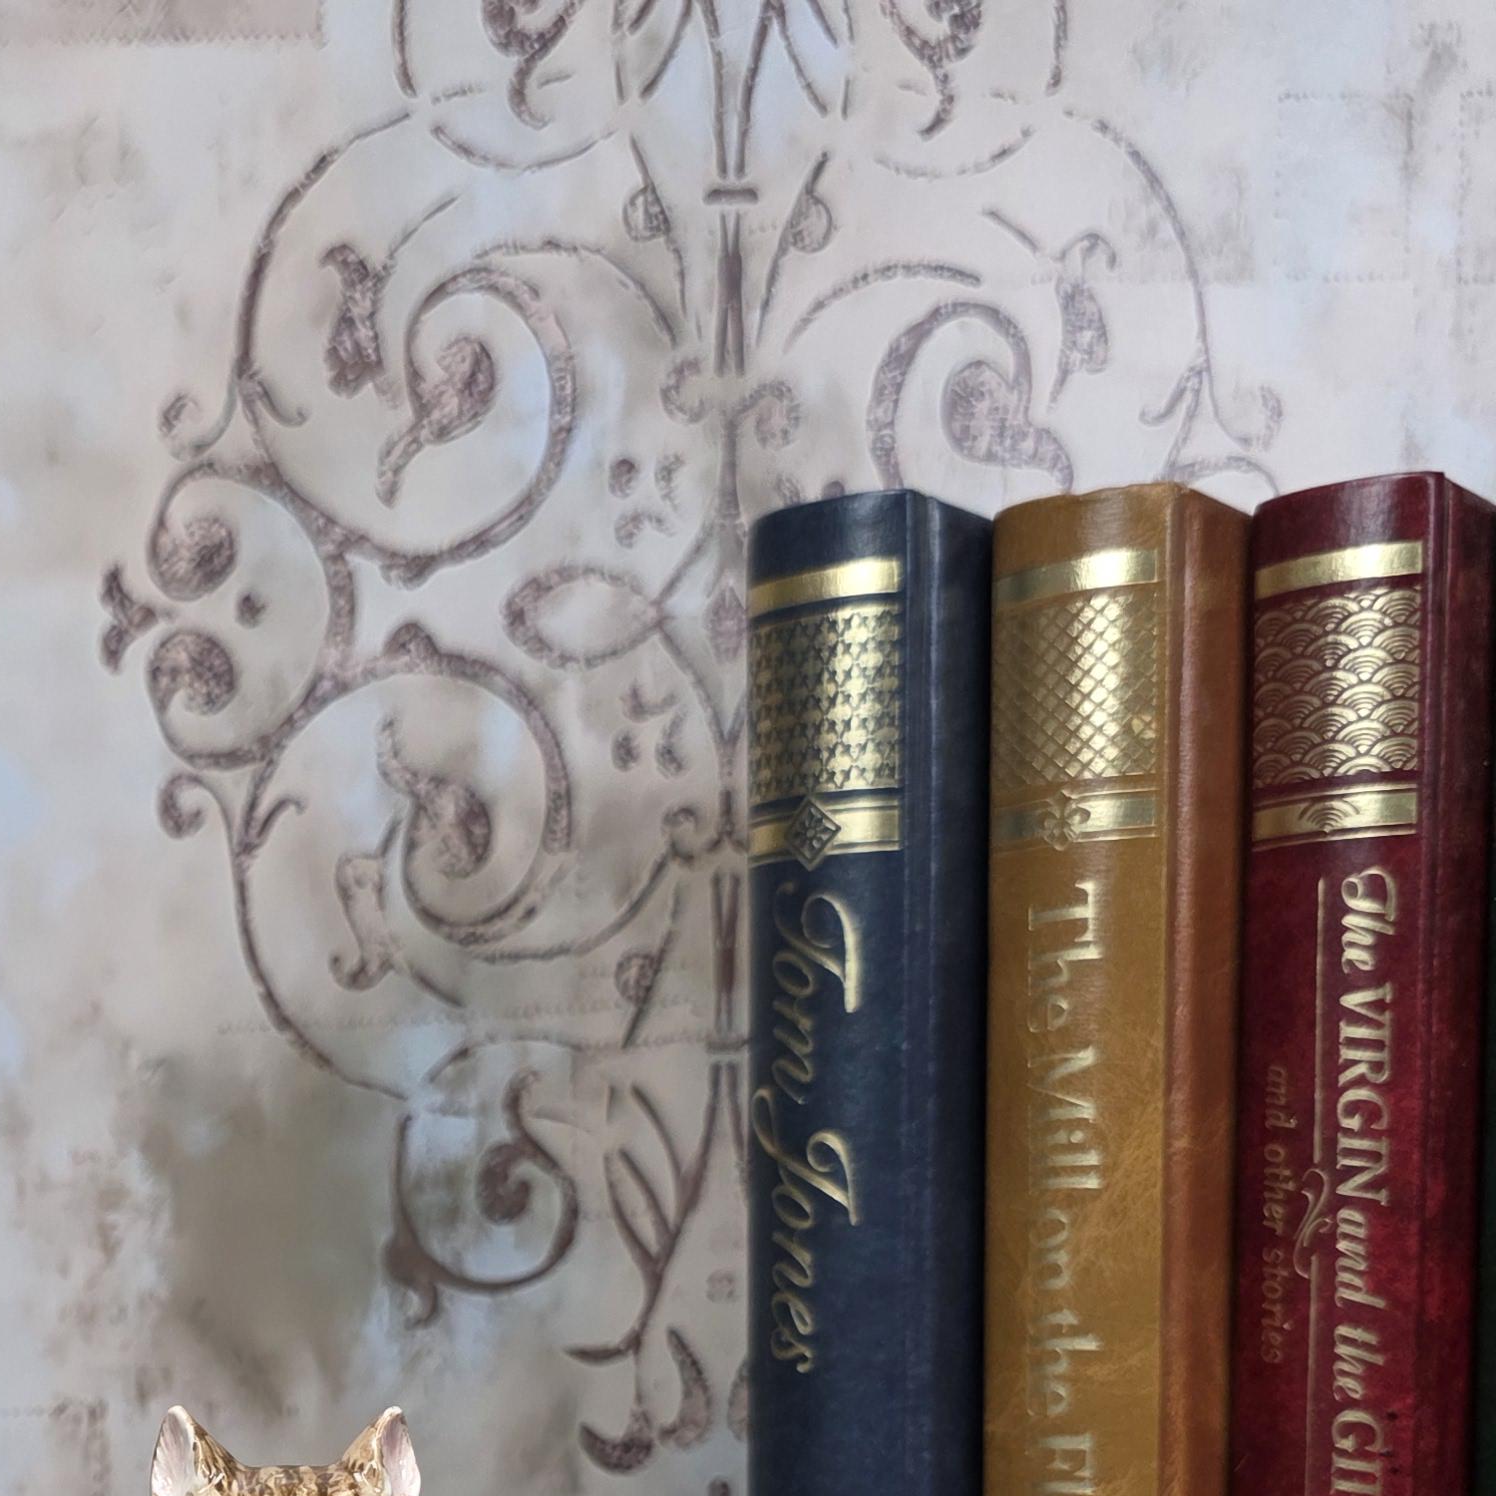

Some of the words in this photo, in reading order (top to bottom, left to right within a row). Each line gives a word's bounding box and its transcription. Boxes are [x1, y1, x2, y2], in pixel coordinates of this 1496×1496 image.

[1027, 879, 1103, 1033] The
[1340, 865, 1397, 975] The
[773, 882, 860, 1104] Tom
[1027, 1046, 1103, 1194] Mill
[1264, 1065, 1298, 1129] and
[1335, 981, 1395, 1207] VIRGIN
[752, 1087, 860, 1373] Jones
[1263, 1142, 1296, 1236] other
[1028, 1207, 1072, 1290] on
[1334, 1209, 1386, 1309] and
[1260, 1248, 1292, 1364] stories
[1026, 1307, 1101, 1417] the
[1333, 1323, 1386, 1403] the
